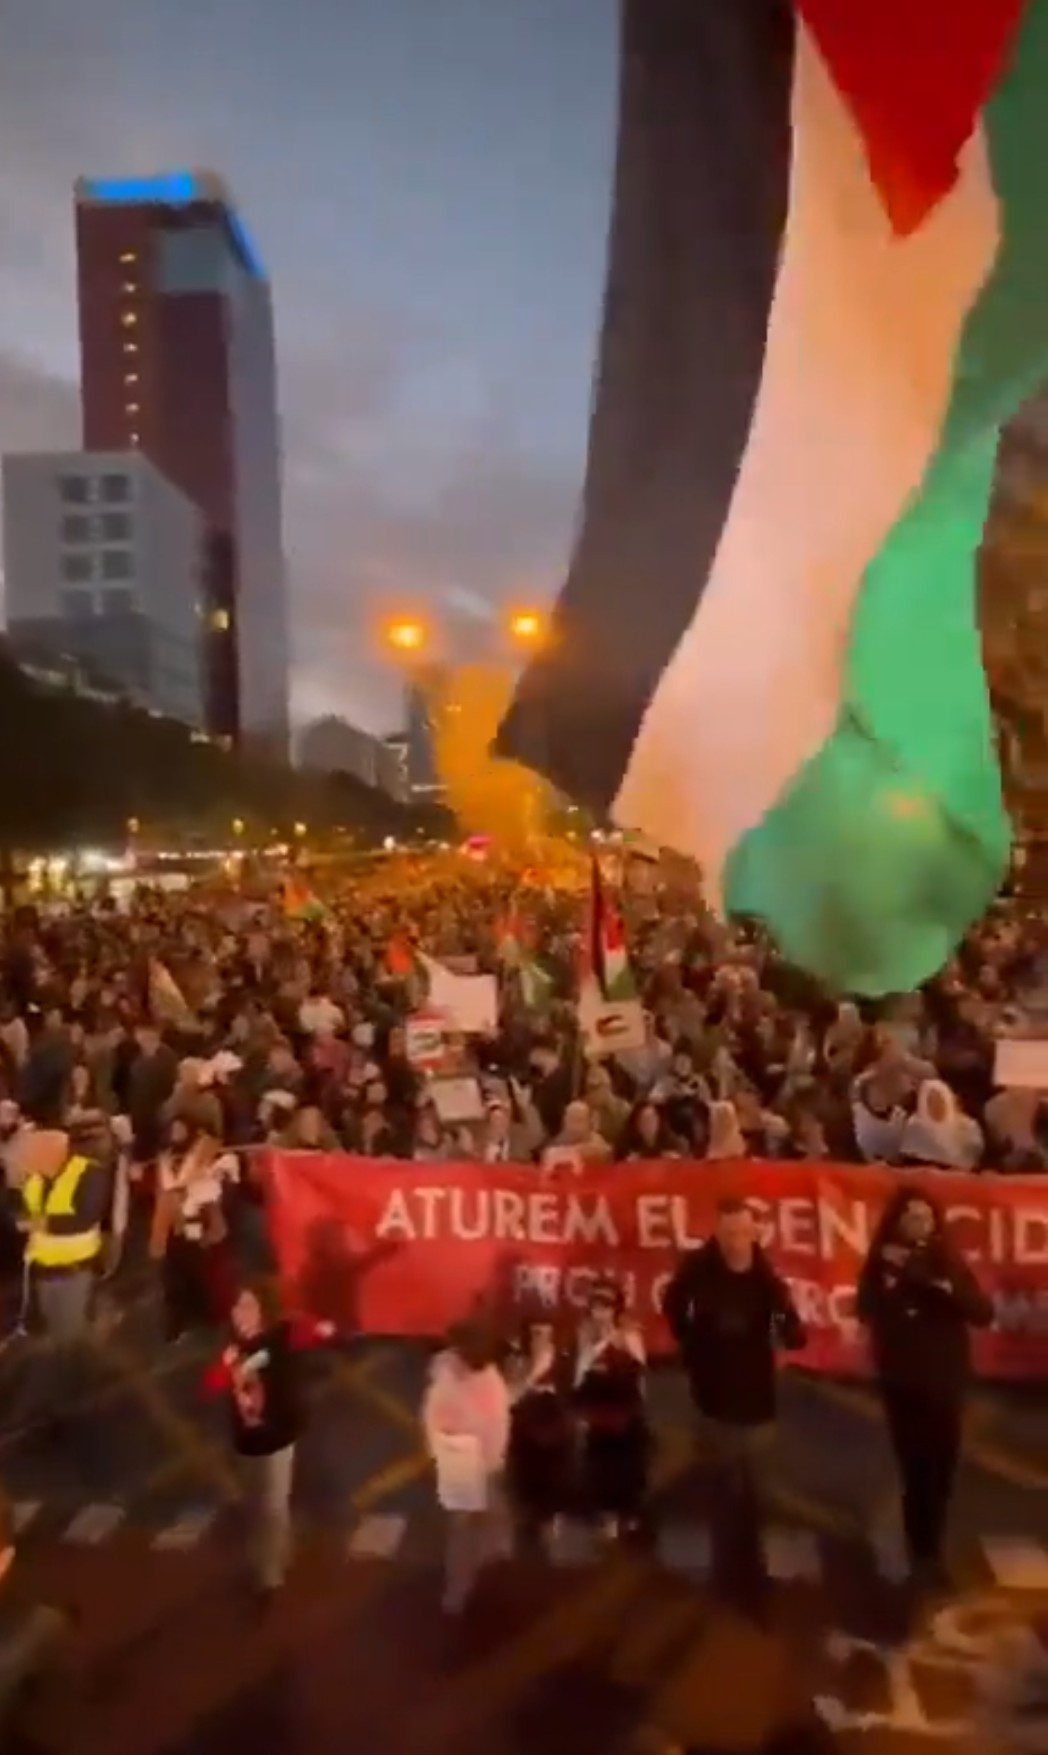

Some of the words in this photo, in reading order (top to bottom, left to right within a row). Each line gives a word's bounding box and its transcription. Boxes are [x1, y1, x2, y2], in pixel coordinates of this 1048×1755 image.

[375, 1187, 620, 1247] ATUREM
[636, 1195, 704, 1250] EL
[743, 1195, 1048, 1265] GENCID
